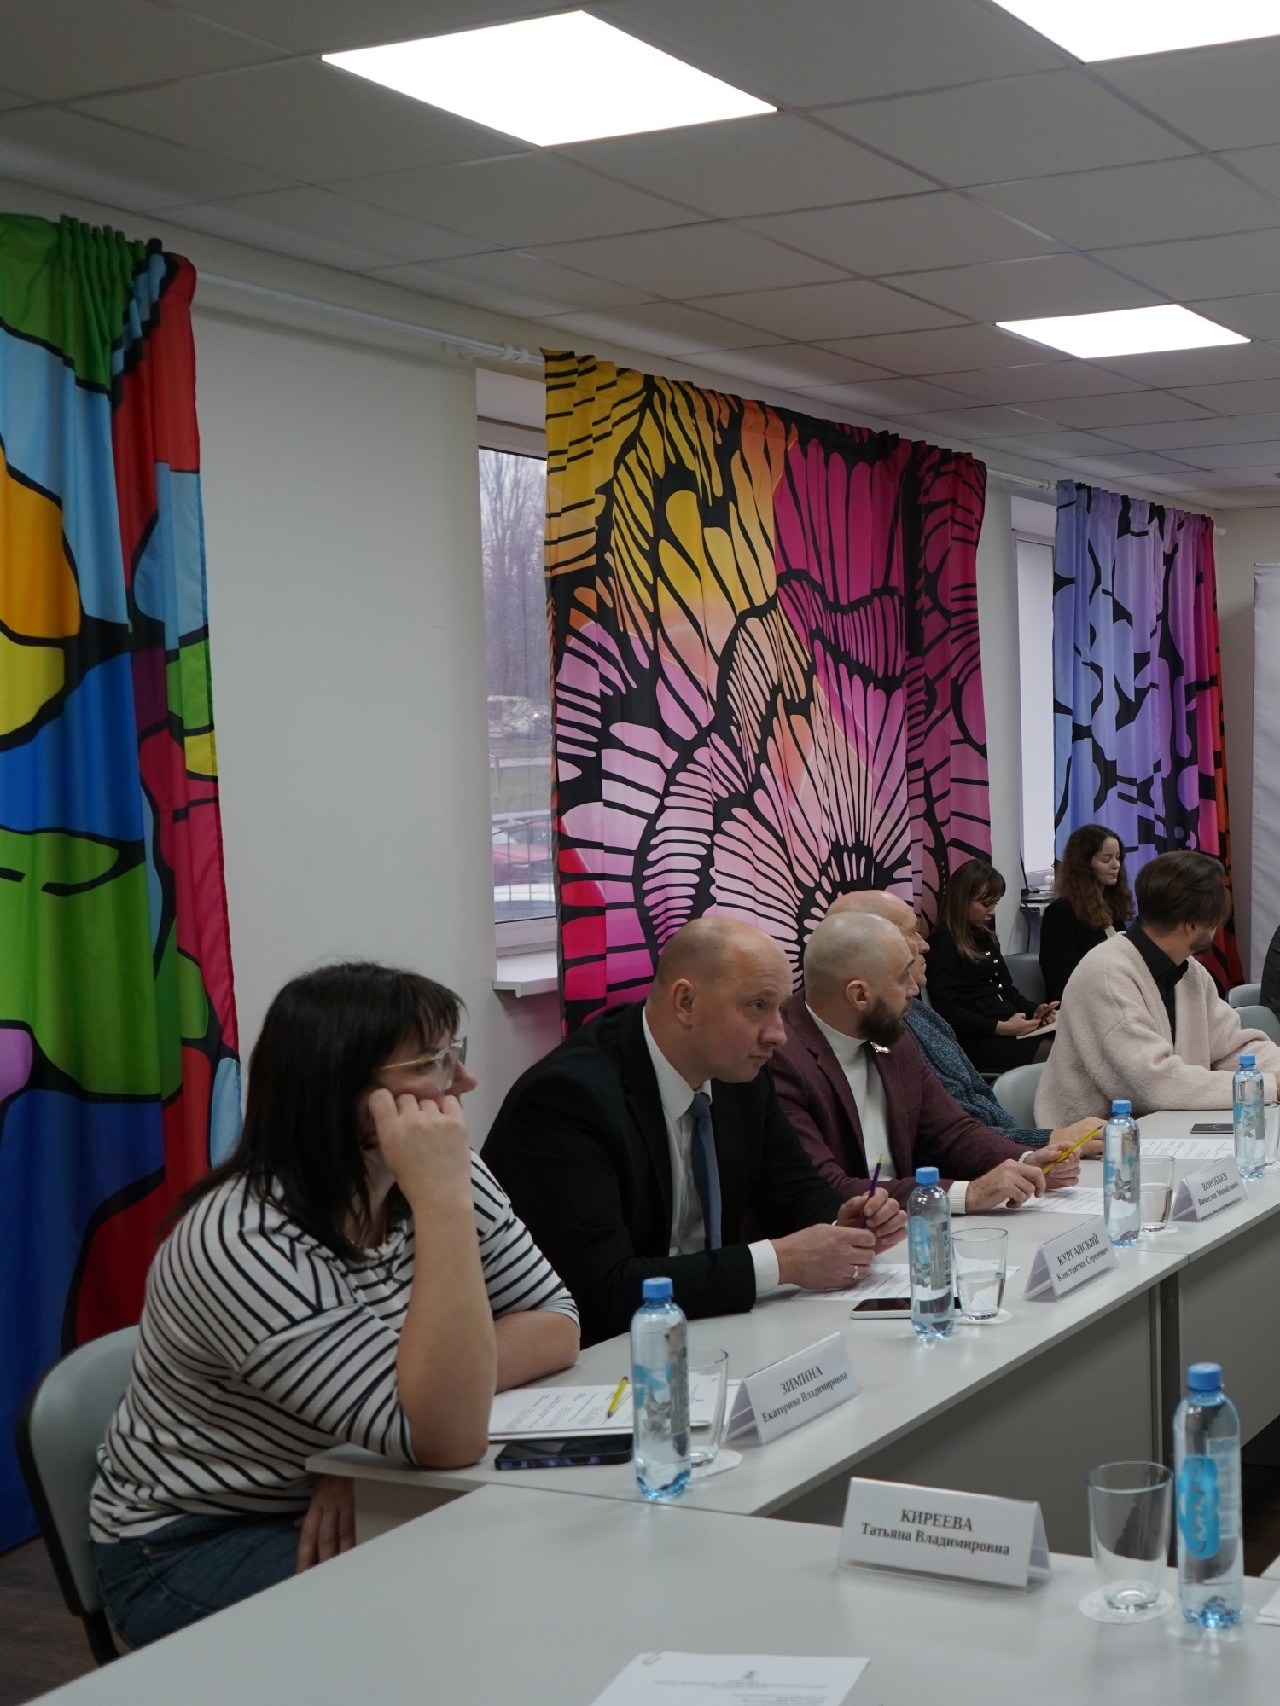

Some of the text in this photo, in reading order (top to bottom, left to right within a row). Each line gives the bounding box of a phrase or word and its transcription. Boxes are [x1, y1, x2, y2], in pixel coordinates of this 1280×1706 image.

[1056, 1232, 1100, 1266] КУРГАНСКИЙ
[761, 1371, 848, 1423] Екатерина Владимировна
[780, 1365, 824, 1396] ЗИМИНА
[900, 1508, 973, 1532] КИРЕЕВА
[861, 1522, 1010, 1556] Татьяна Владимировна
